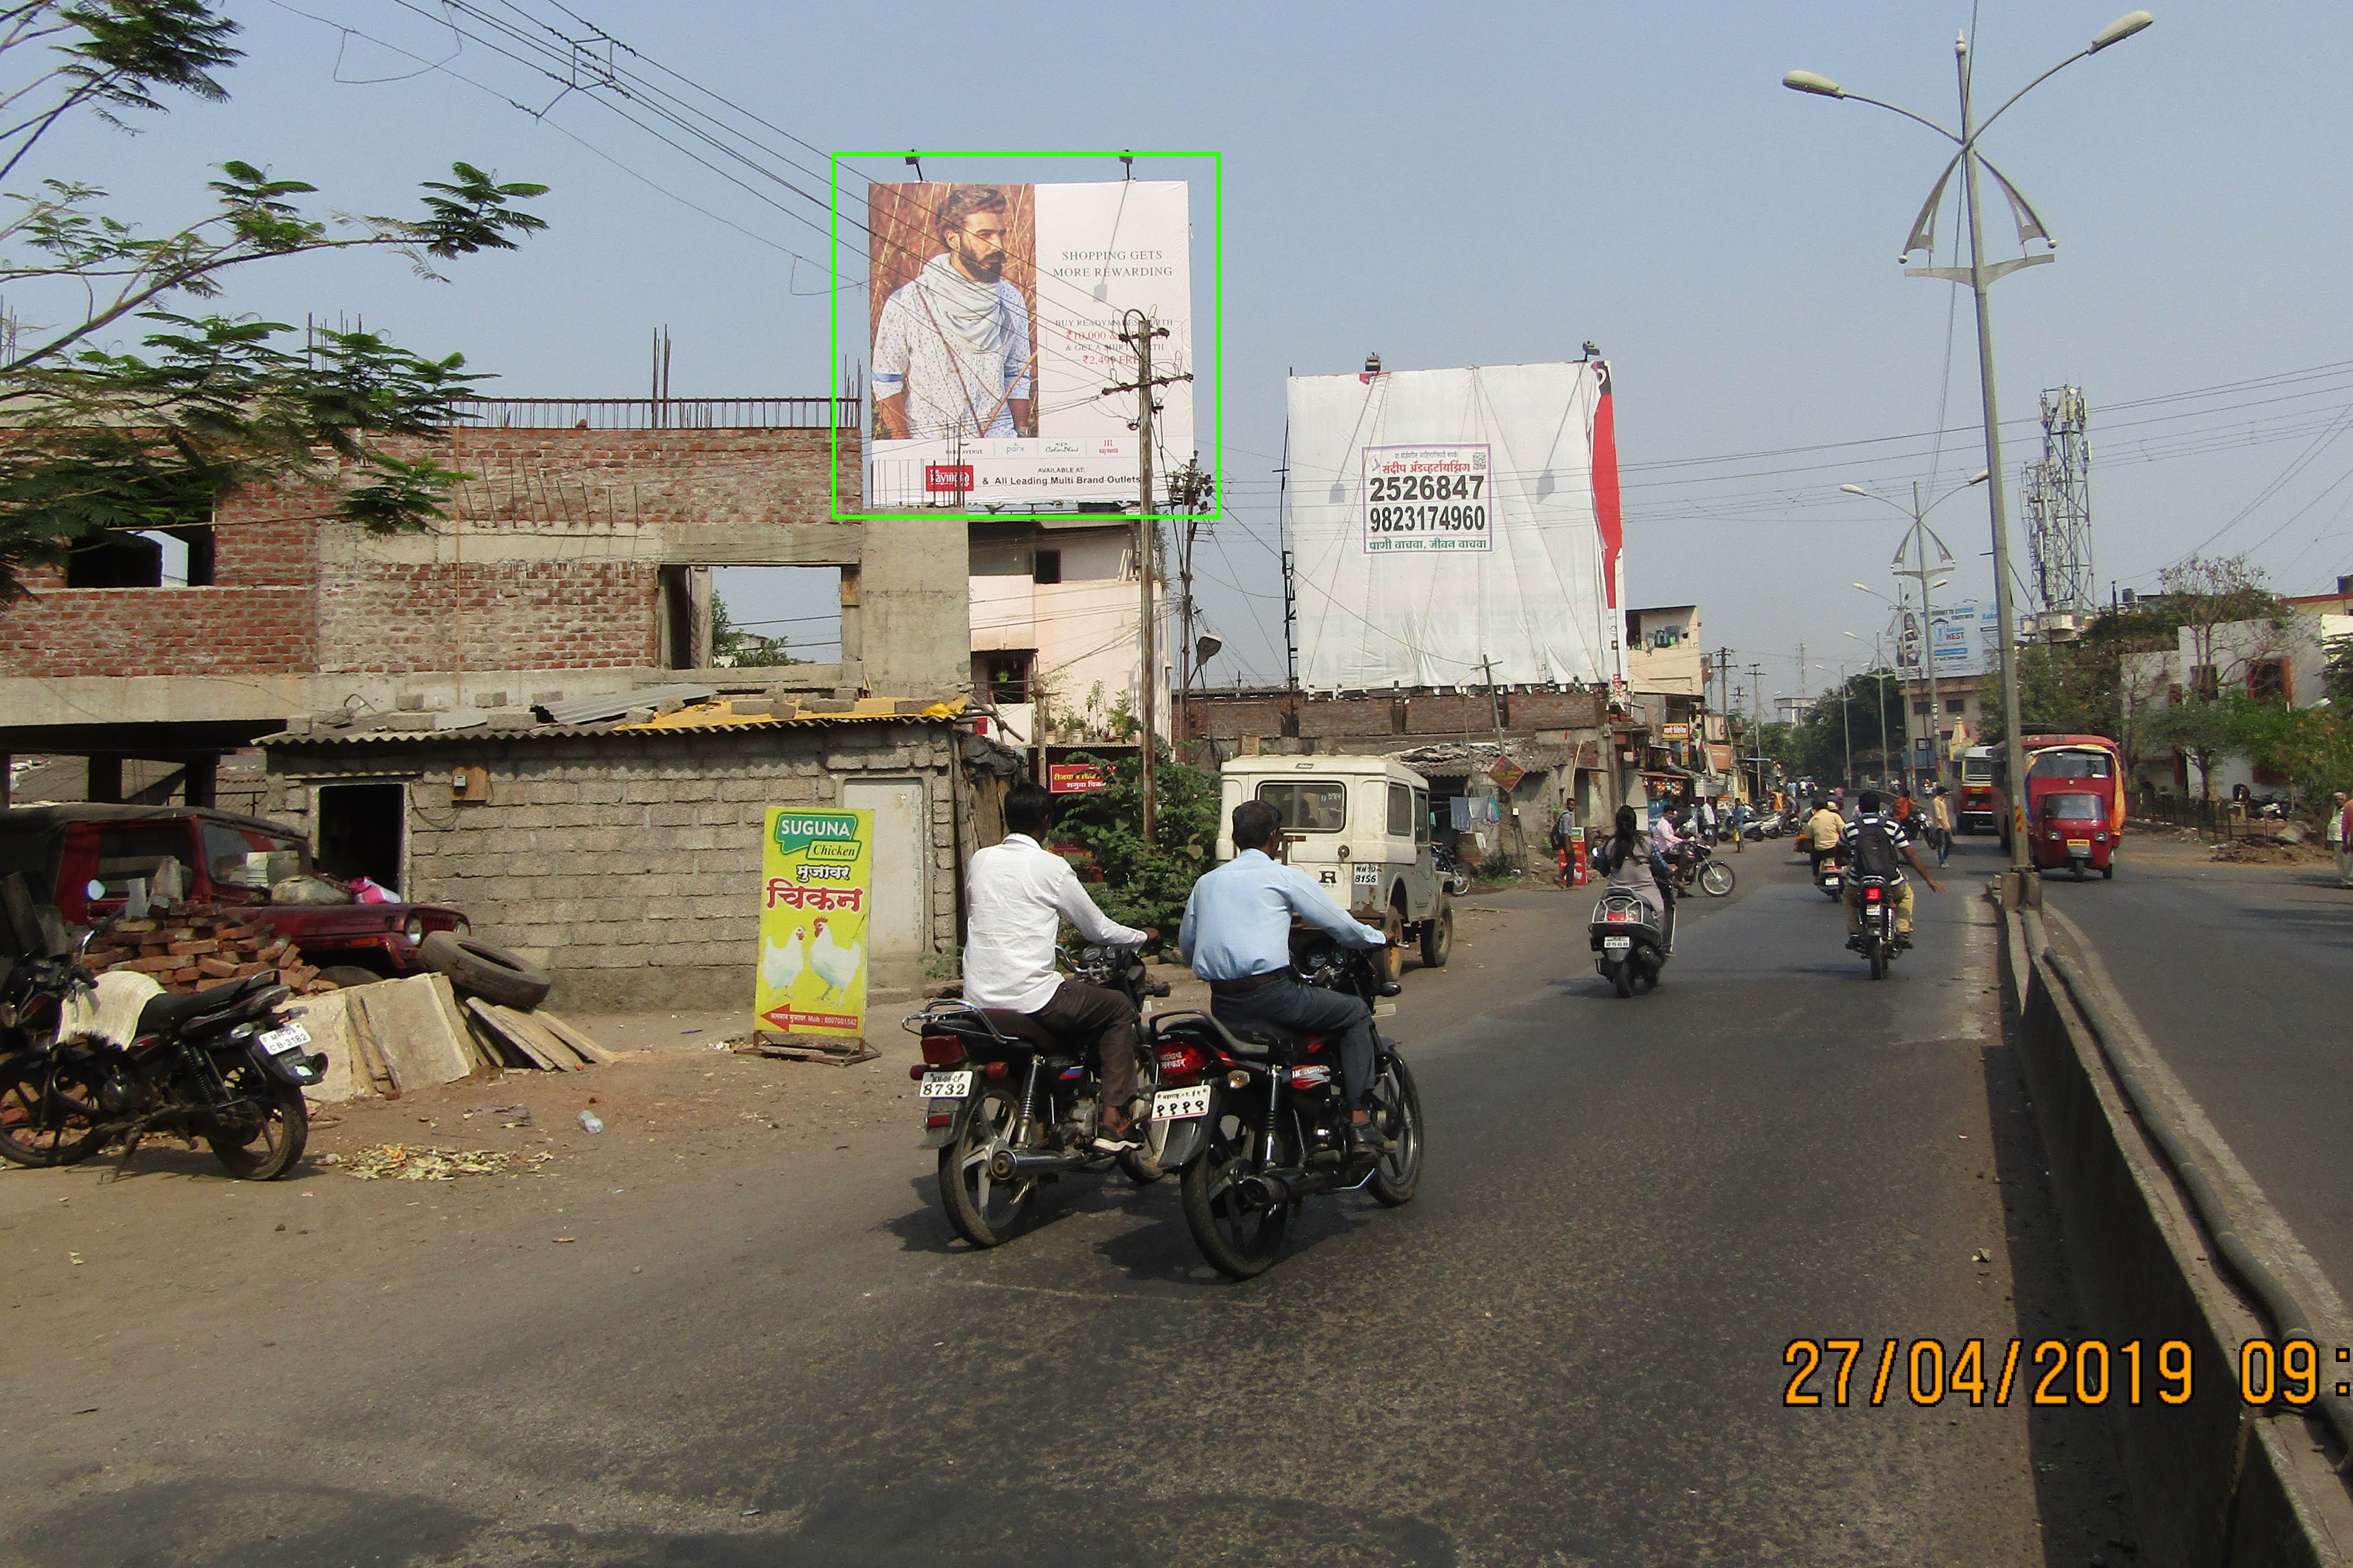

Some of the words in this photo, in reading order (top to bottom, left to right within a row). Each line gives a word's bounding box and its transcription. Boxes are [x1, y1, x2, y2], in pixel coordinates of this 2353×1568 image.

[1062, 251, 1126, 261] SHOPPING
[1130, 251, 1163, 260] GETS
[1053, 268, 1090, 277] MORE
[1095, 267, 1172, 277] REWARDING
[1382, 461, 1406, 474] संदीप
[1010, 477, 1047, 486] Leading
[1051, 476, 1073, 484] Multi
[1076, 476, 1104, 484] Brand
[1107, 475, 1141, 483] Outlets
[1369, 475, 1484, 502] 2526847
[1370, 505, 1485, 532] 9823174960
[1369, 538, 1392, 550] पाणी
[1429, 538, 1455, 549] जीवन
[1458, 540, 1487, 549] वाचवा
[1946, 632, 1965, 640] NEST
[781, 820, 851, 836] SUGUNA
[813, 844, 855, 856] Chicken
[796, 864, 851, 883] मुजावर
[1354, 874, 1376, 883] 8156
[766, 878, 863, 912] चिकन
[923, 1083, 965, 1095] 8732
